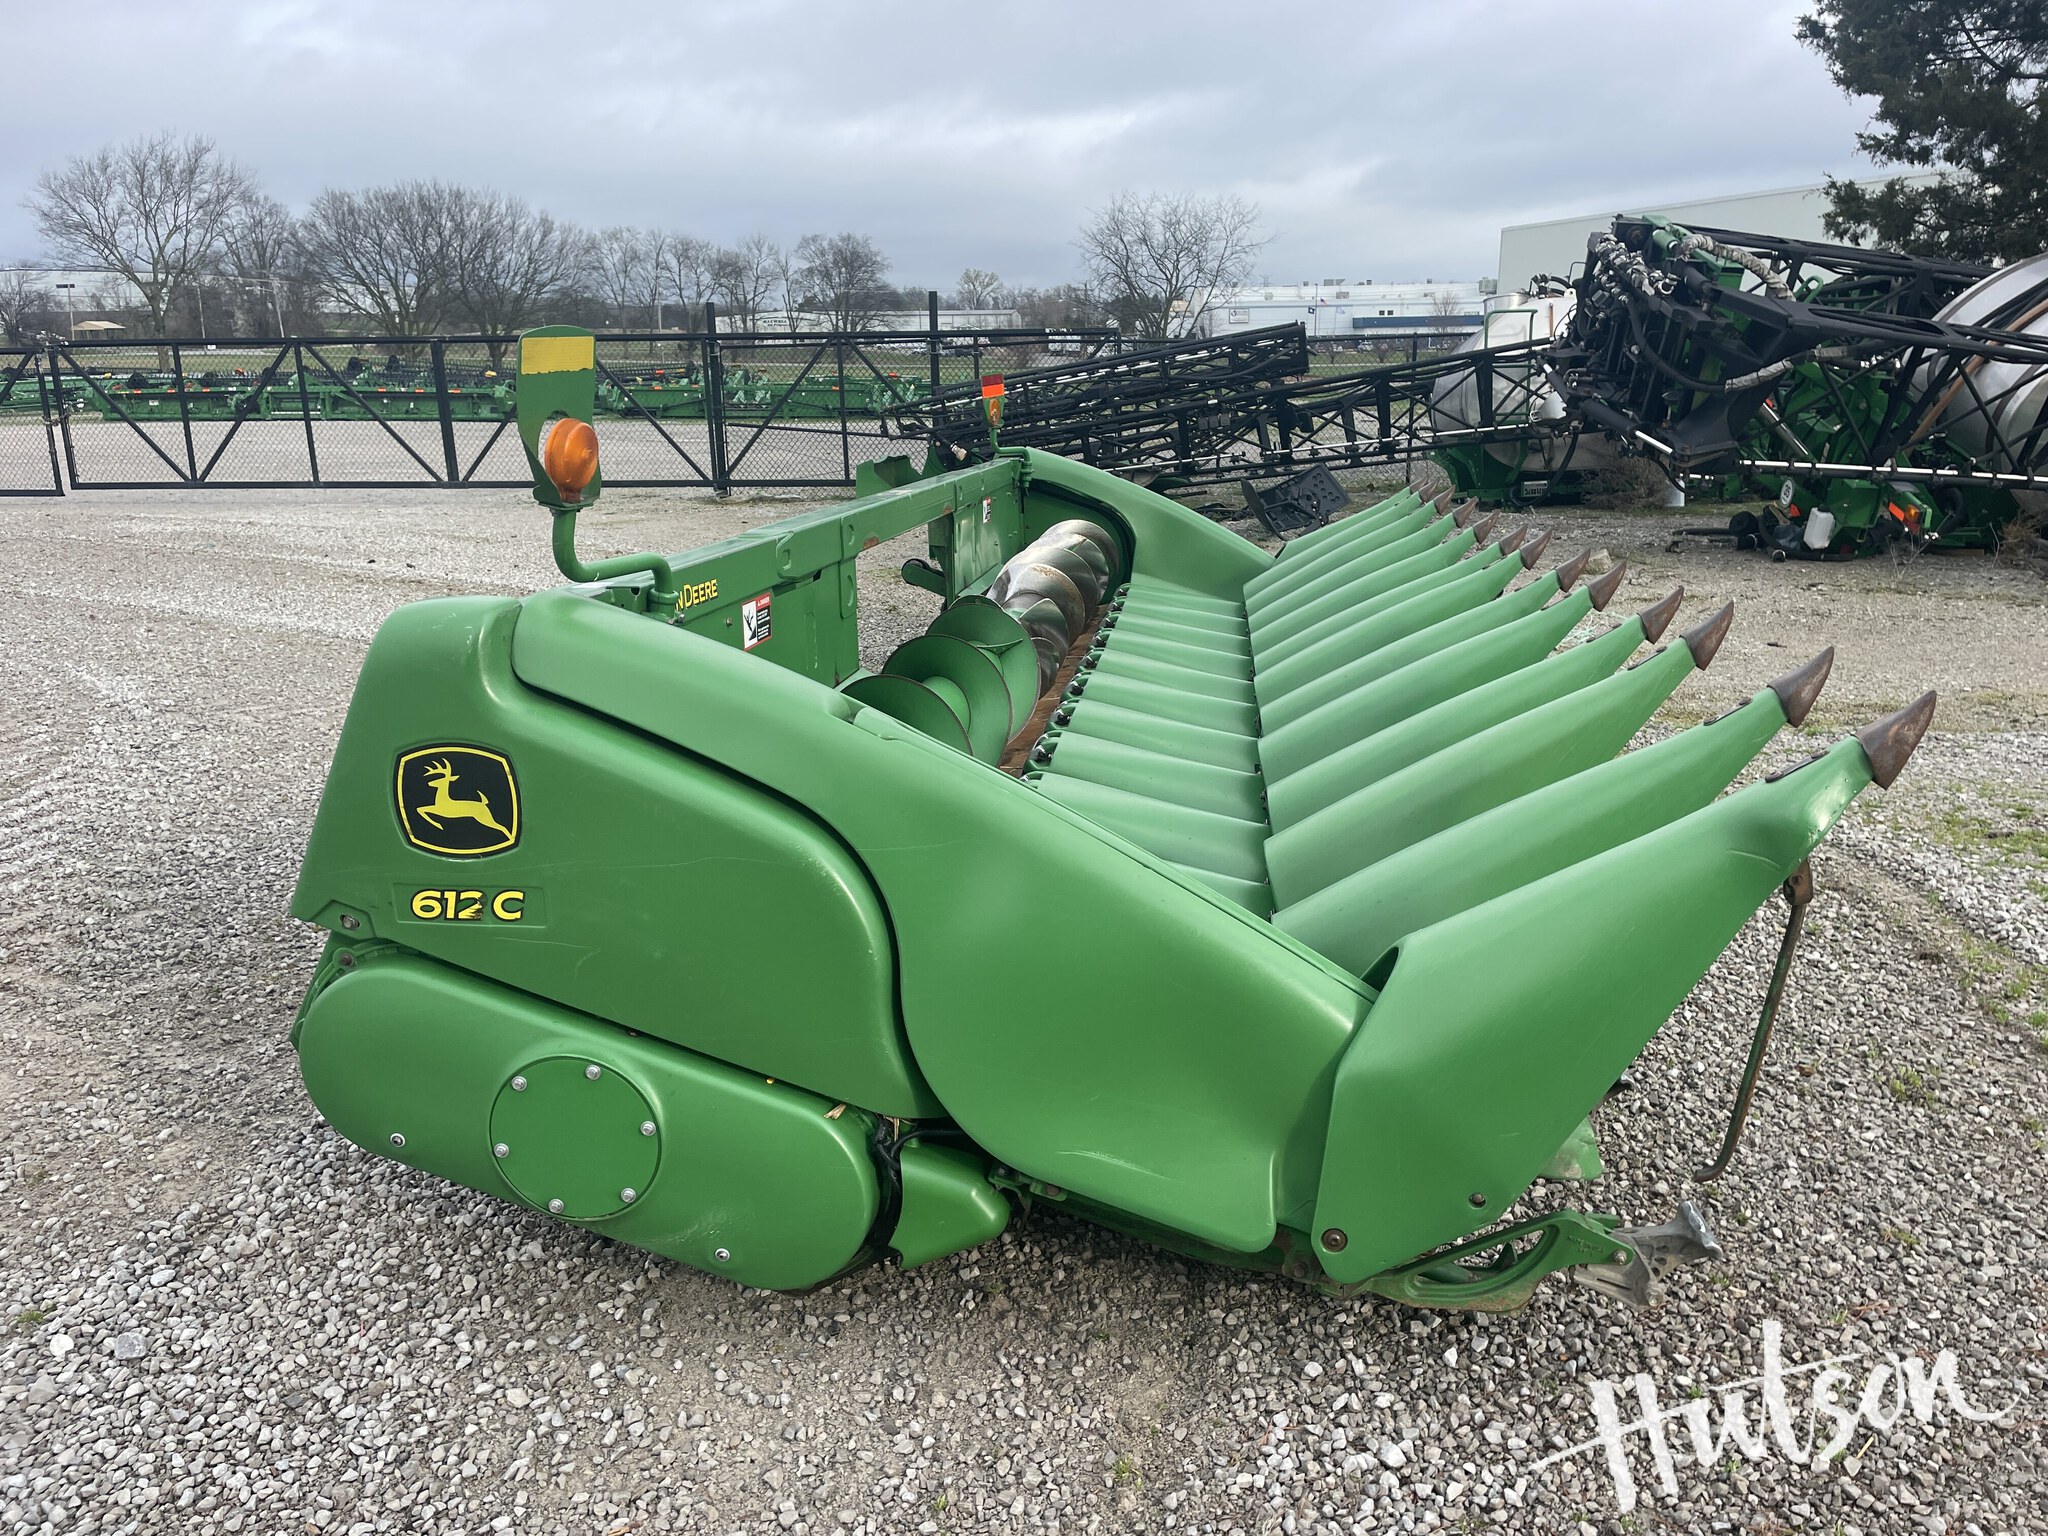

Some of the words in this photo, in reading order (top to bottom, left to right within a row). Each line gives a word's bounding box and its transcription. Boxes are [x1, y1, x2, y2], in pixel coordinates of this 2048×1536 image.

[683, 579, 718, 609] DEERE
[411, 888, 486, 920] 612
[492, 888, 525, 921] C
